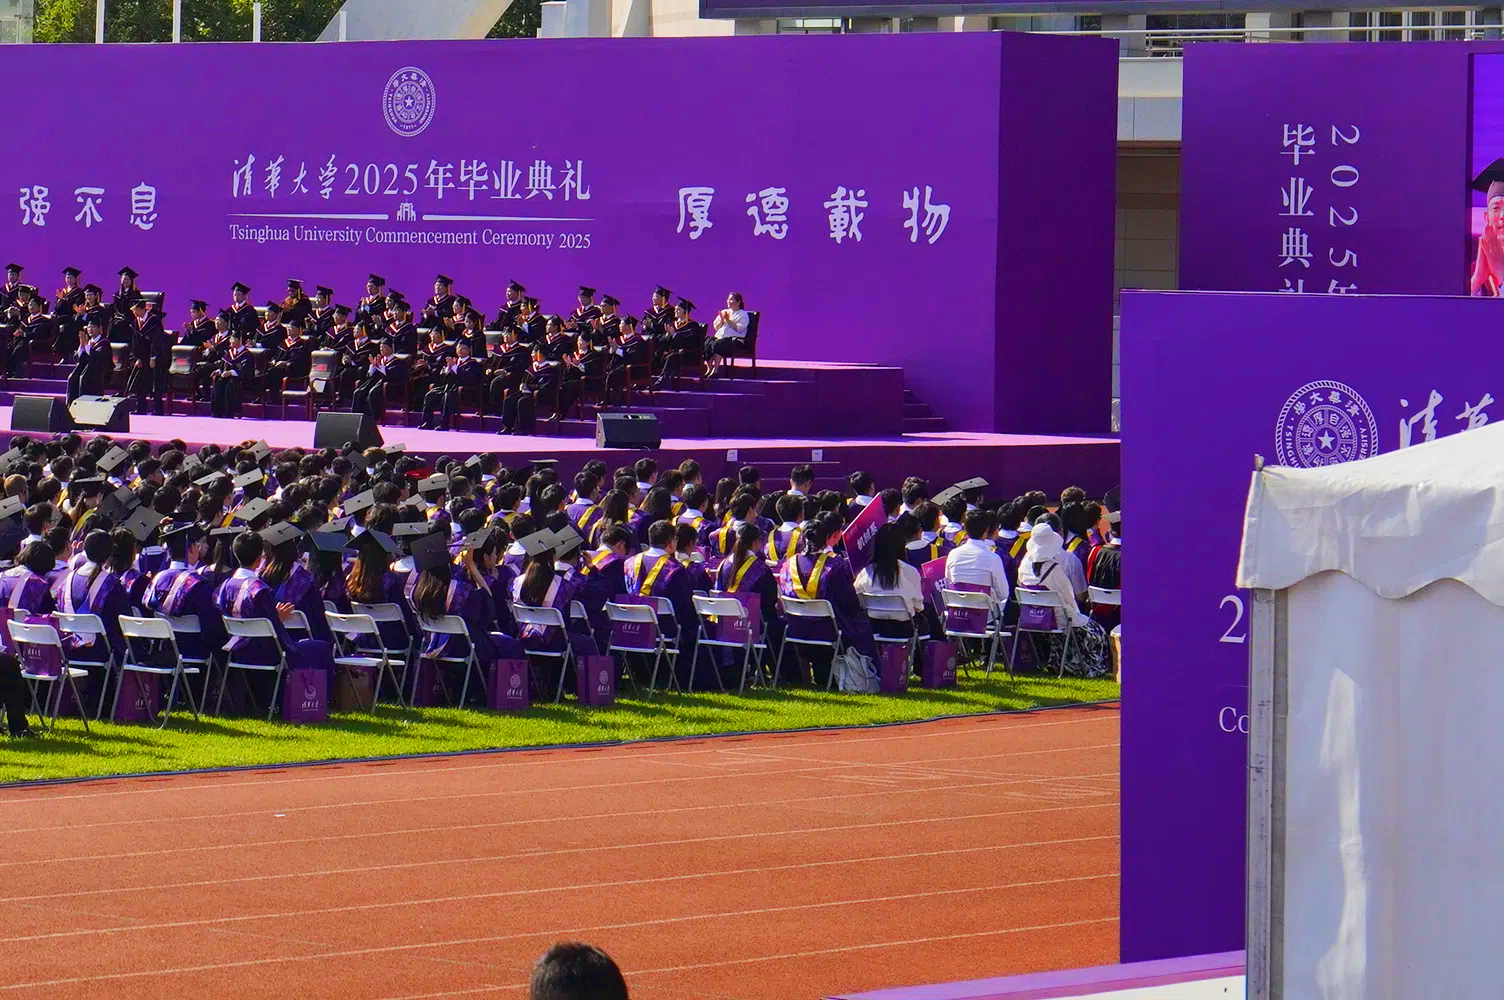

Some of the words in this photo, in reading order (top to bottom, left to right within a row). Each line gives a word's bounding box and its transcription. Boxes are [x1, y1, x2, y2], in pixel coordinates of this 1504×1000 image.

[230, 225, 289, 244] Tsinghua
[294, 226, 362, 245] University
[365, 227, 478, 245] Commencement
[482, 229, 555, 249] Ceremony
[559, 233, 591, 249] 2025
